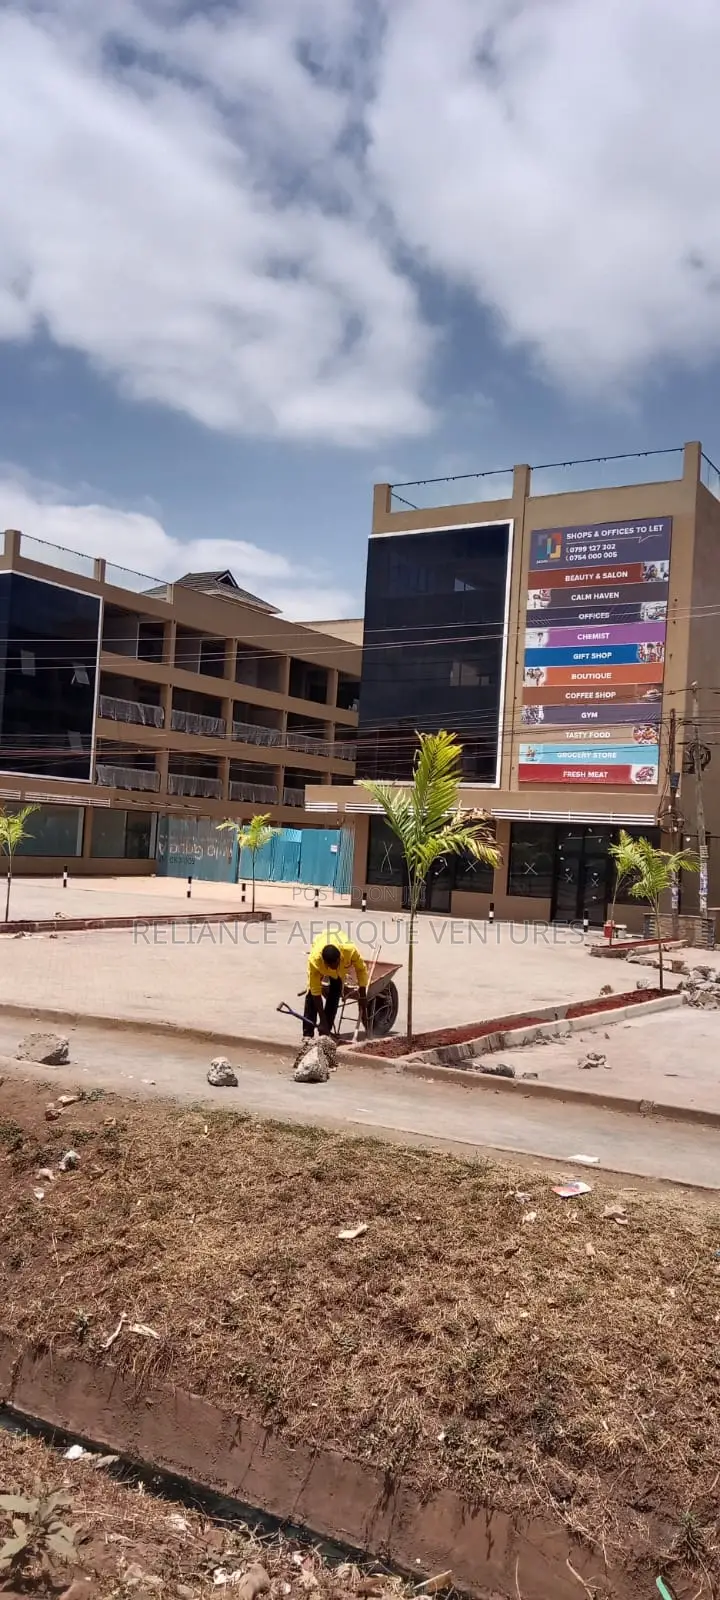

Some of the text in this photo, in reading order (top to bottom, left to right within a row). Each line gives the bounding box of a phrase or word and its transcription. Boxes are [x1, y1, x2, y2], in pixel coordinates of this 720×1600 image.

[601, 528, 634, 537] OFFICES
[649, 524, 663, 532] LET
[565, 574, 593, 582] BEAUTY
[578, 612, 610, 620] OFFICES
